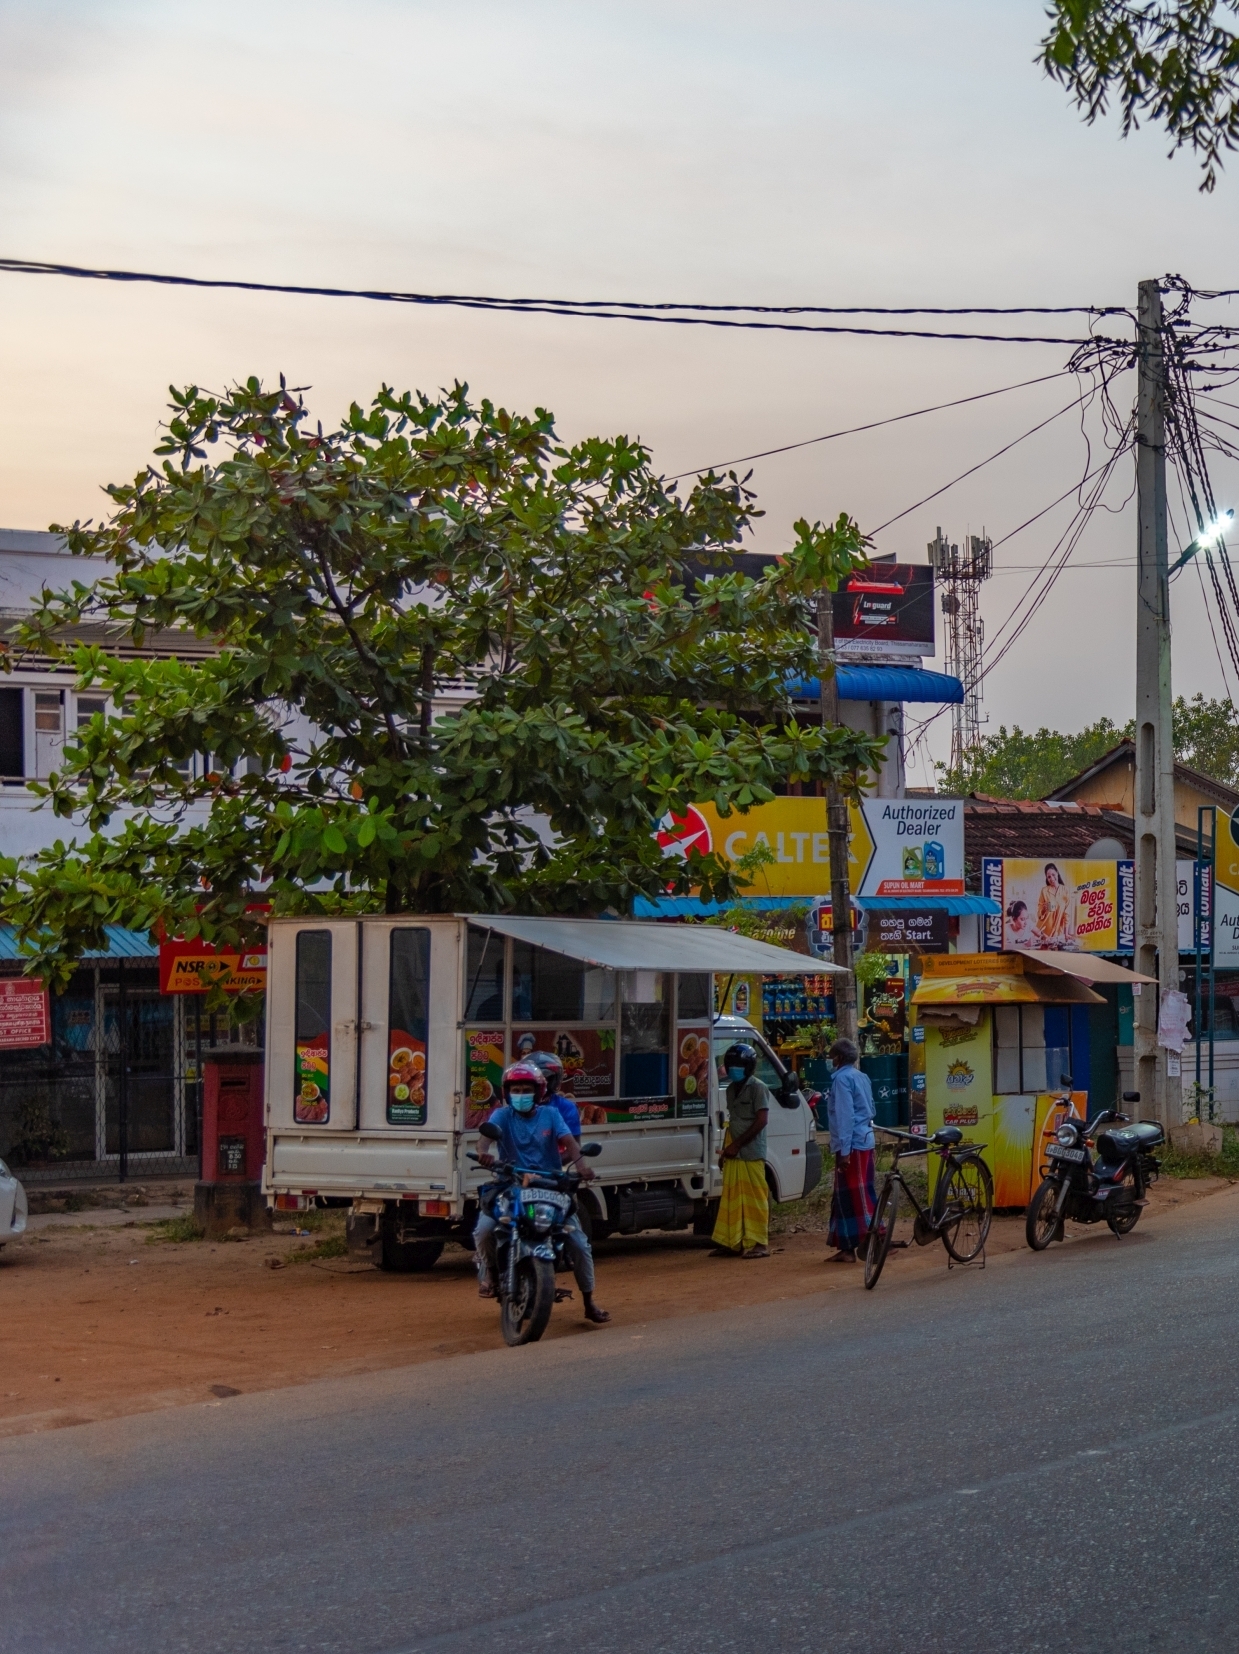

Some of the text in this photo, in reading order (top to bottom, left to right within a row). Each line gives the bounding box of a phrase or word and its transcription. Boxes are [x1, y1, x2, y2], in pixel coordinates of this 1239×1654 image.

[882, 805, 956, 820] Authorized
[896, 820, 941, 835] Dealer
[986, 863, 1003, 948] Nesmalt
[1119, 865, 1134, 946] Nestomalt
[906, 931, 934, 940] Start.
[176, 961, 205, 973] NSB
[175, 977, 200, 986] POS
[1066, 1149, 1084, 1161] 3048
